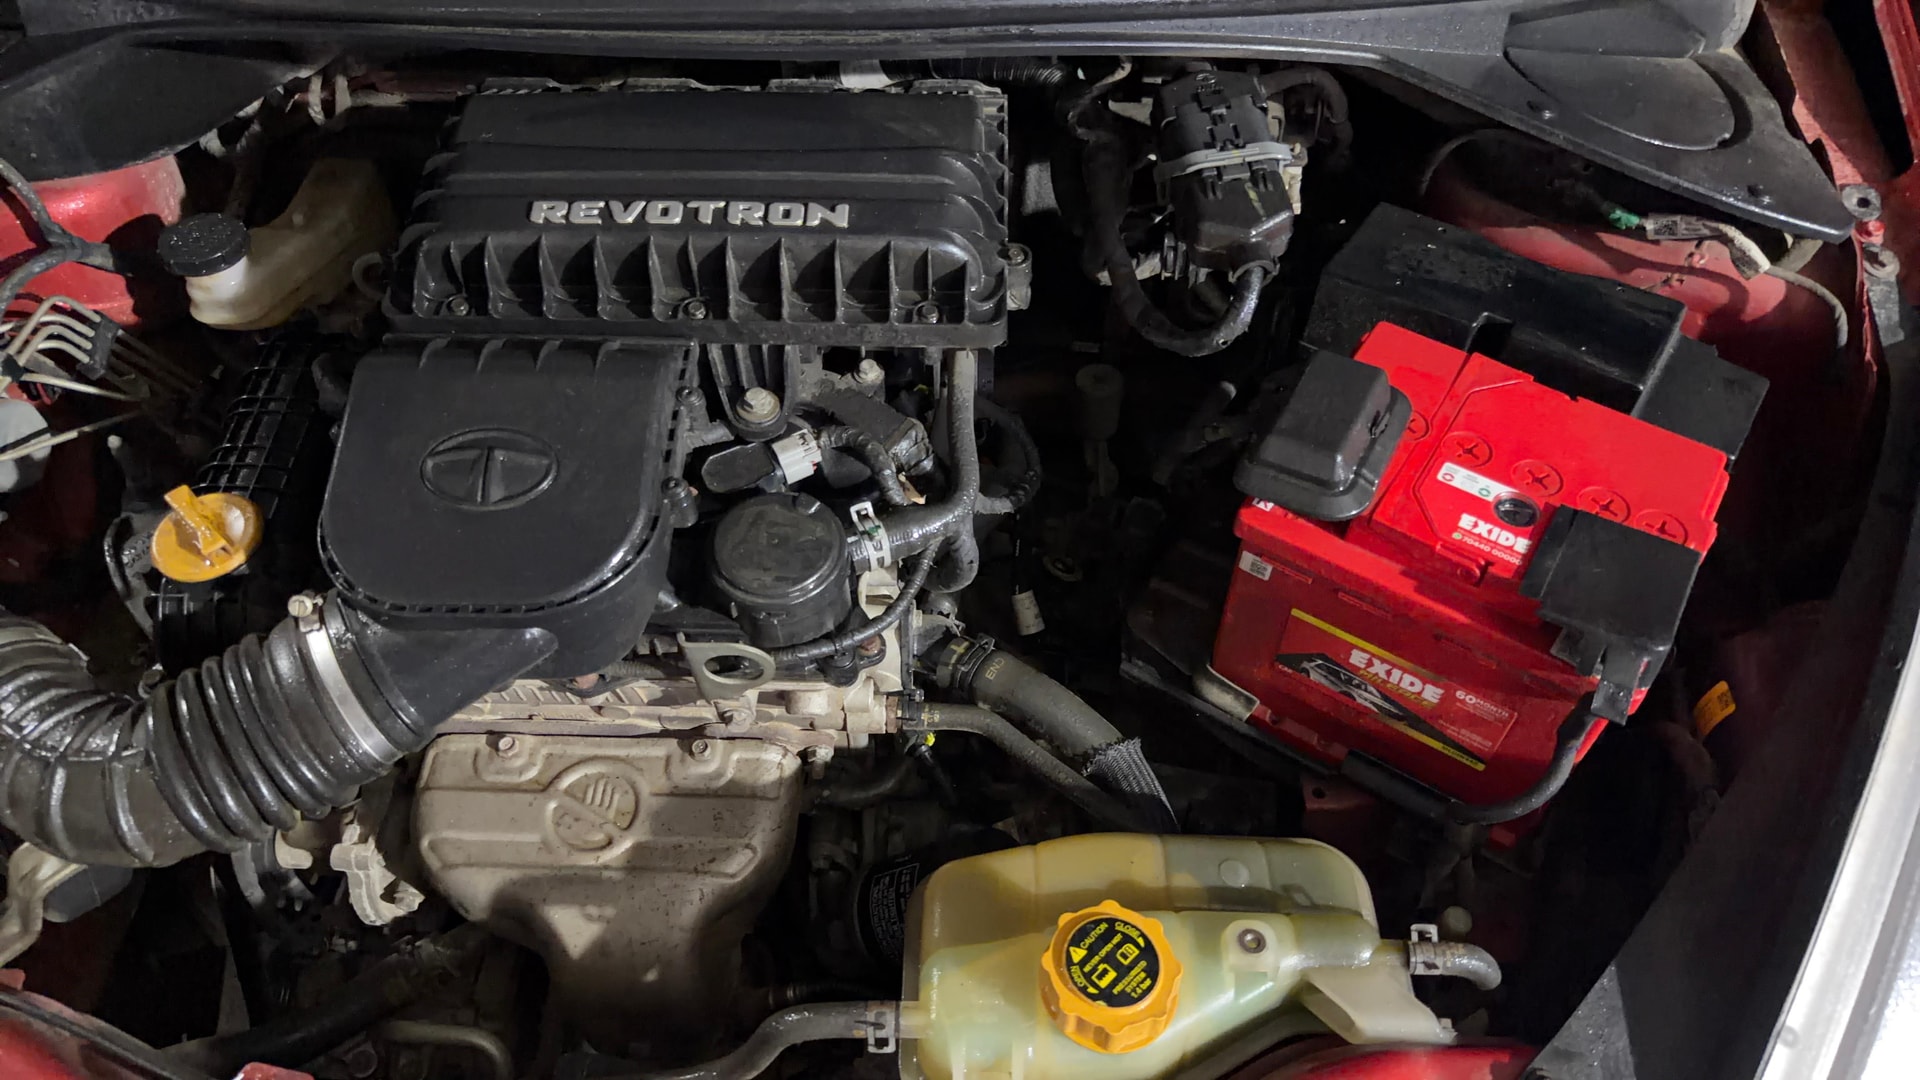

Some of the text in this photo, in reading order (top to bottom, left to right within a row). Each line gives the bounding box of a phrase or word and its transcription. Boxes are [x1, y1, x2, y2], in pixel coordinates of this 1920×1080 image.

[529, 200, 849, 228] REVOTRON
[1458, 513, 1532, 554] EXIDE
[1349, 648, 1445, 704] EXIDE
[1455, 690, 1476, 704] 60
[1080, 921, 1109, 949] CAUTION
[1114, 921, 1141, 940] CLOSE
[1098, 941, 1113, 957] OPEN
